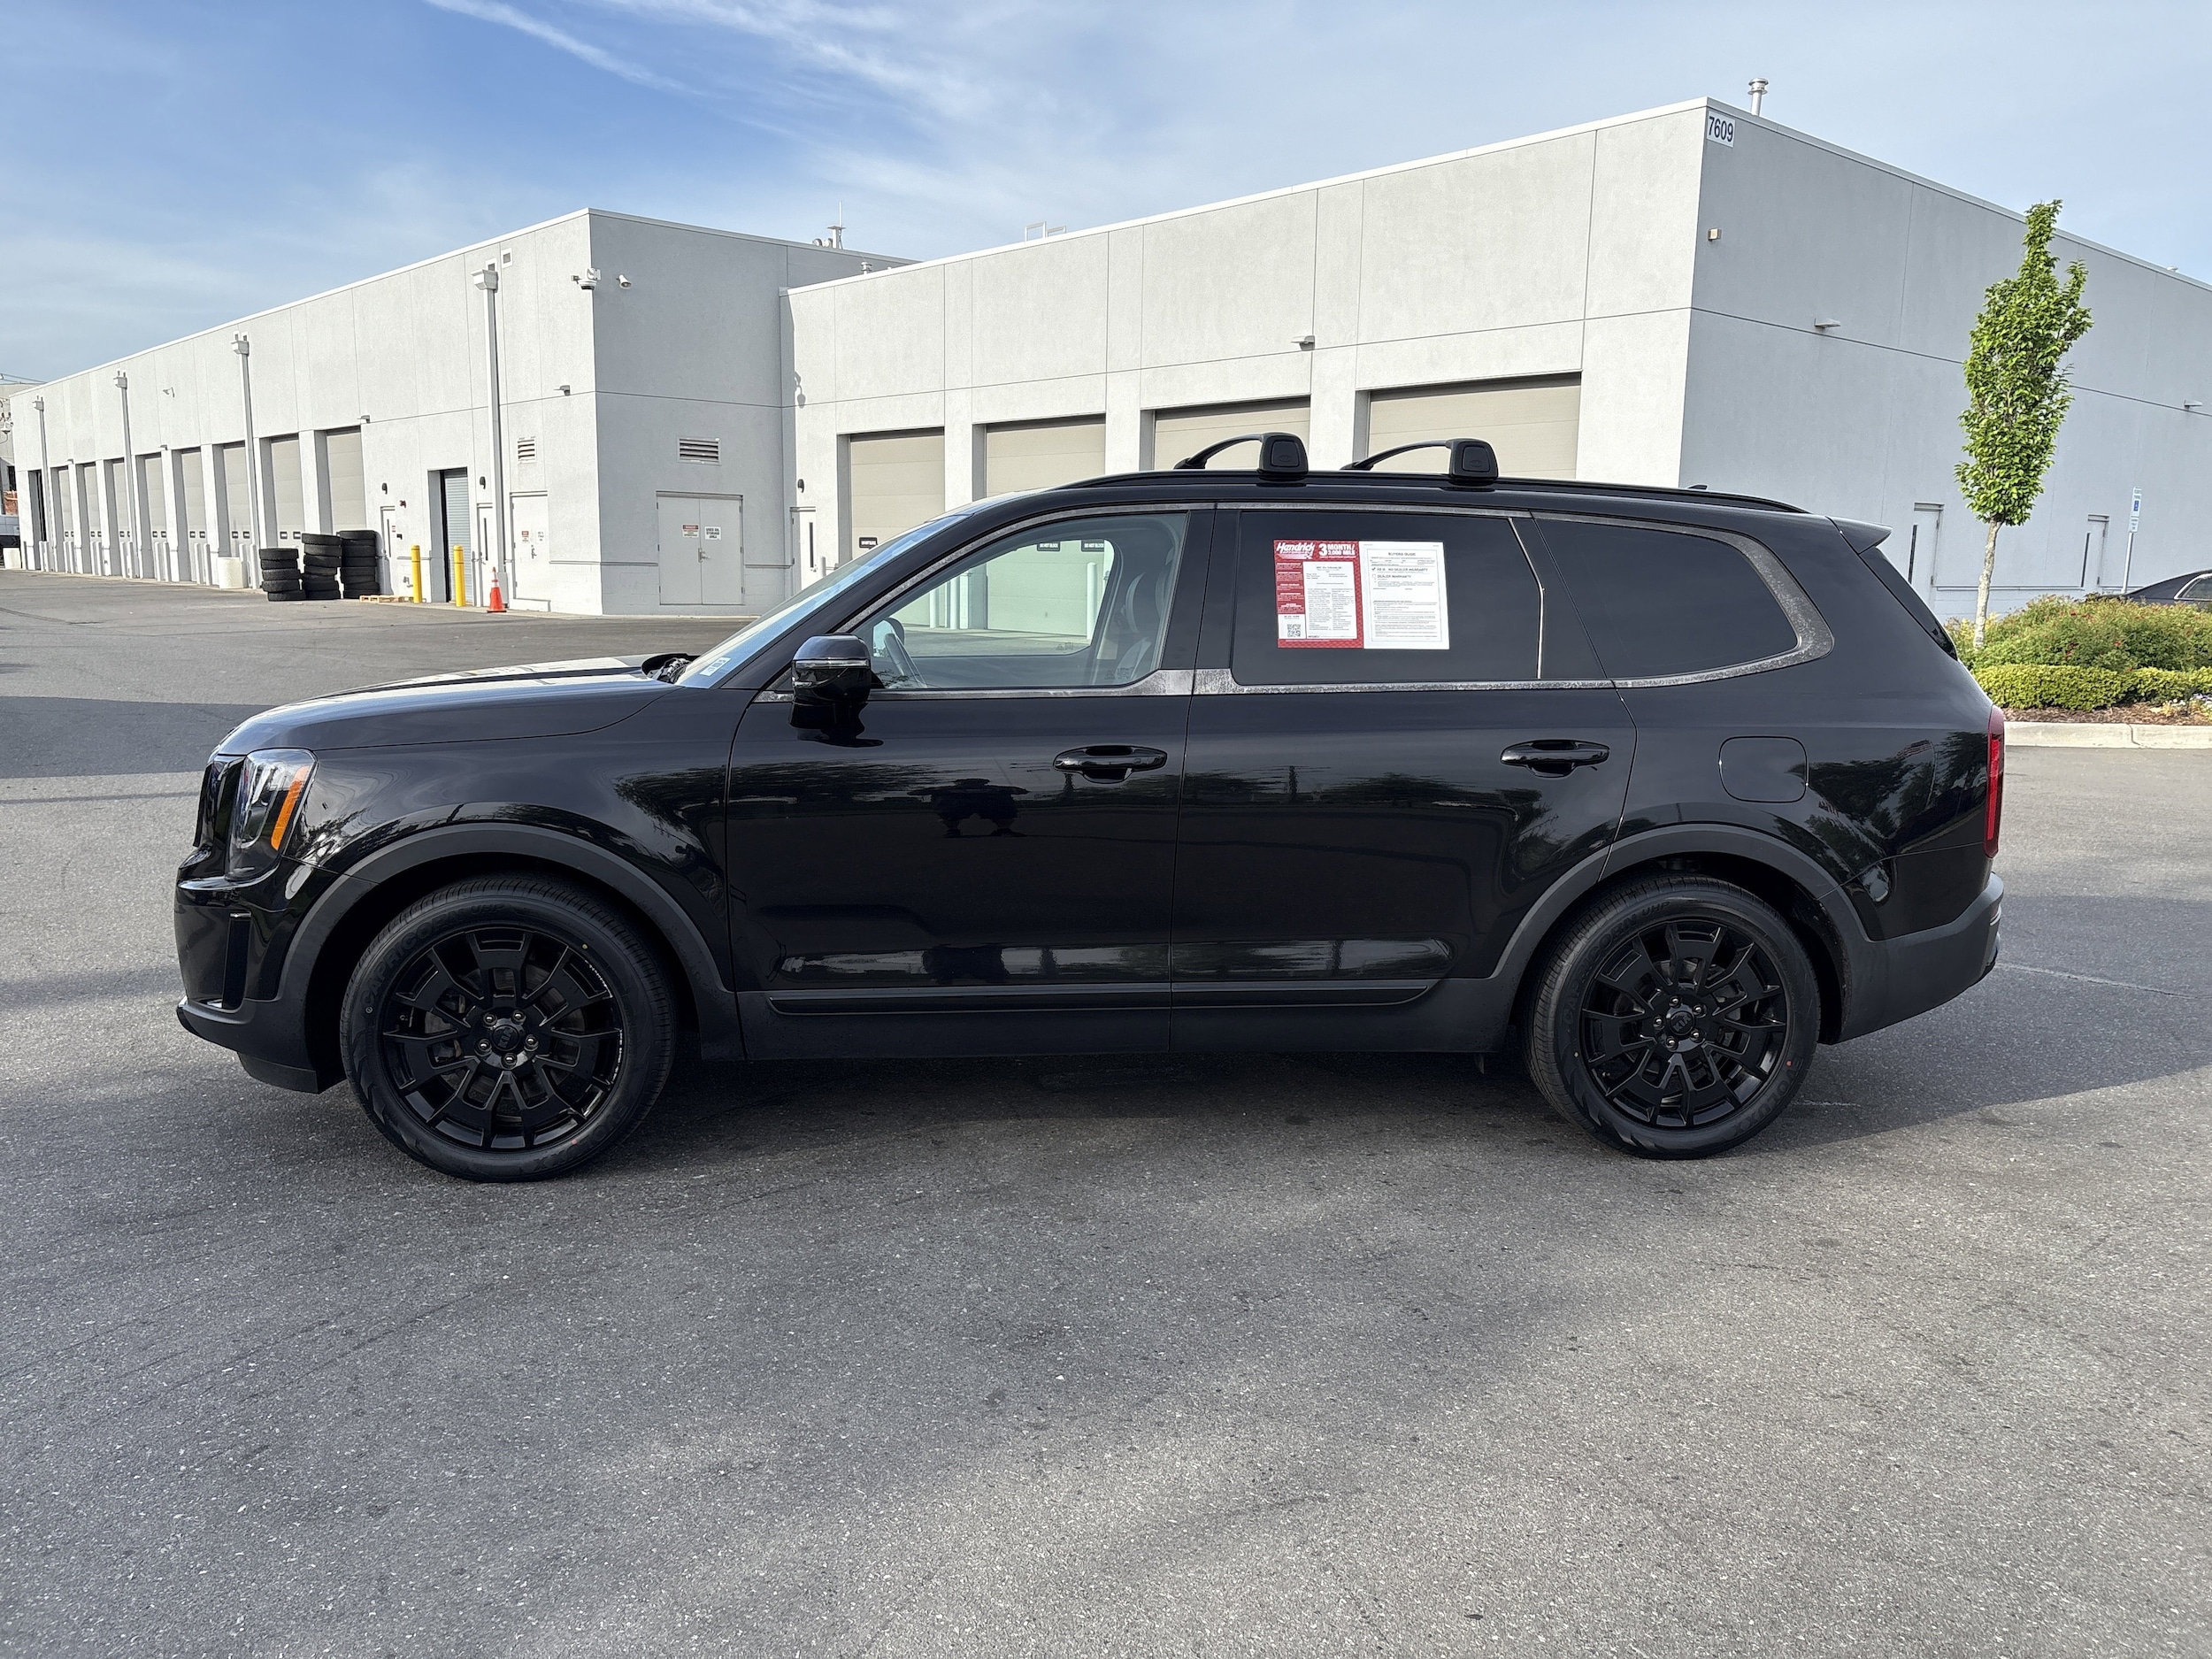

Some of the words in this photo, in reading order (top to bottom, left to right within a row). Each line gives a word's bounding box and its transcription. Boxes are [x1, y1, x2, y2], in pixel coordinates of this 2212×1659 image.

[1709, 116, 1733, 142] 7609
[1276, 541, 1315, 554] Hendrick
[1318, 542, 1327, 556] 3
[361, 909, 464, 1005] CAPRICORN
[1563, 913, 1638, 1024] CAPRICORN
[1641, 901, 1671, 916] UHP
